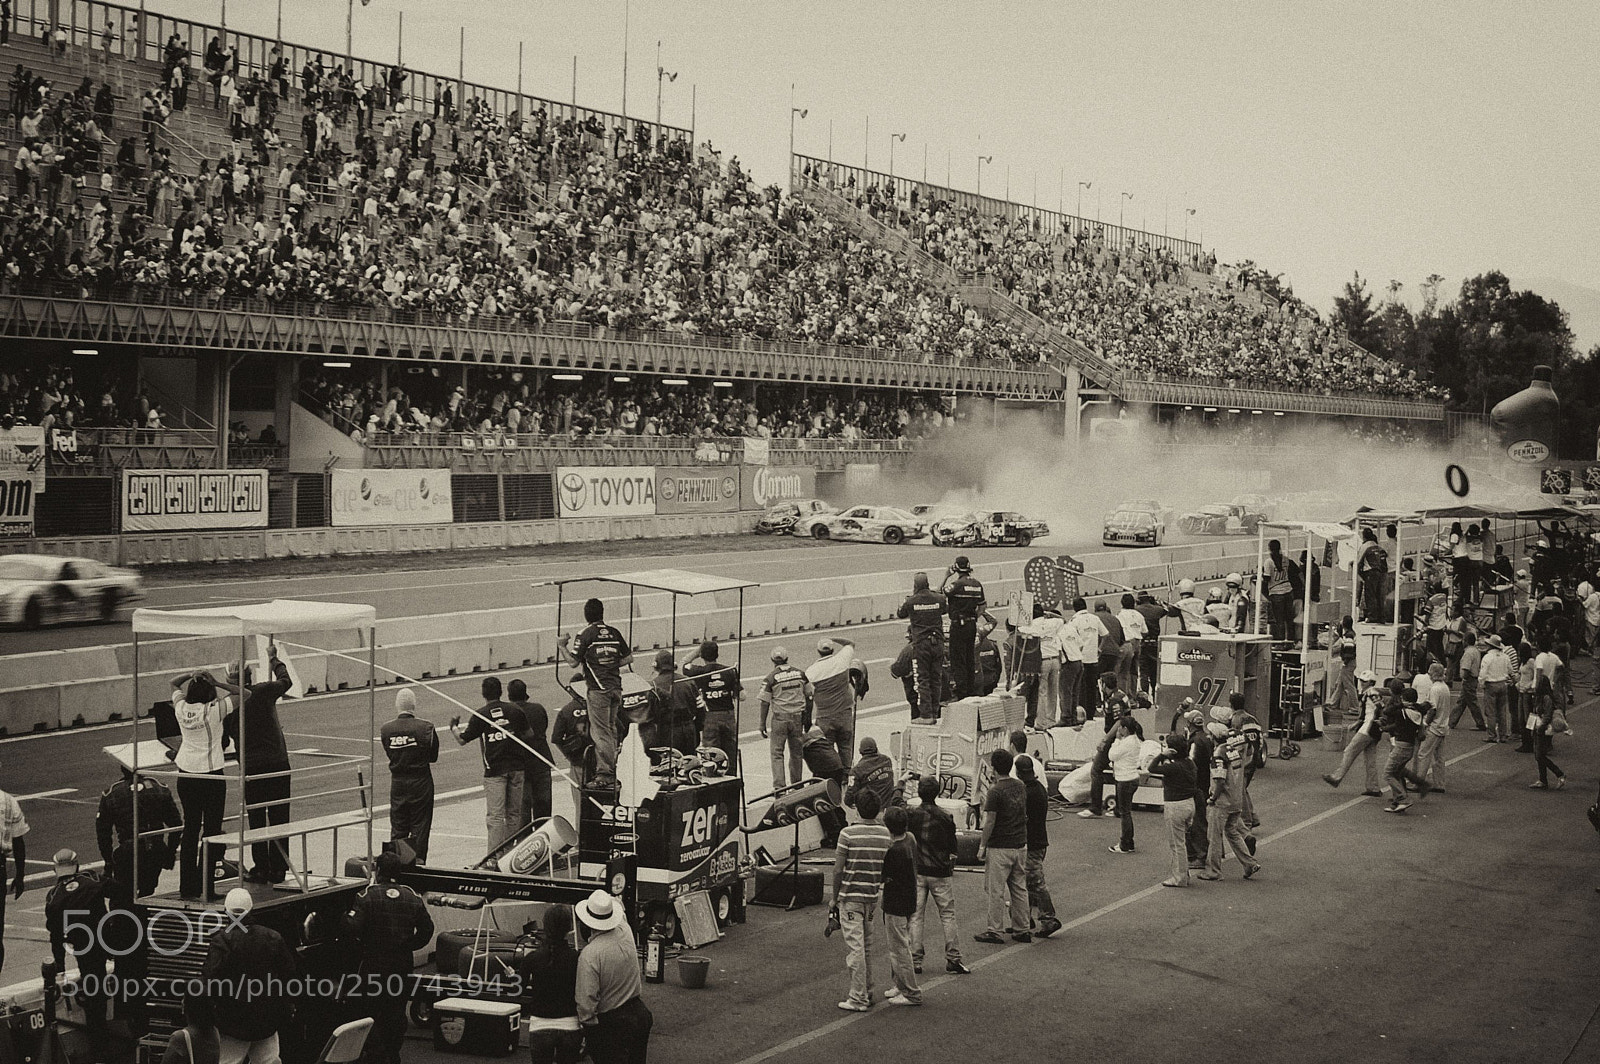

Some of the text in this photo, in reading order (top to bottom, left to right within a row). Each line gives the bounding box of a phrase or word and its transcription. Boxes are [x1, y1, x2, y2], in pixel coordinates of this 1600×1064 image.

[590, 477, 655, 506] TOYOTA
[677, 478, 718, 503] PENNZOIL
[753, 467, 801, 506] Corona
[1194, 677, 1228, 706] 97
[602, 804, 637, 821] zer
[681, 805, 716, 847] zer
[30, 1012, 45, 1030] 08
